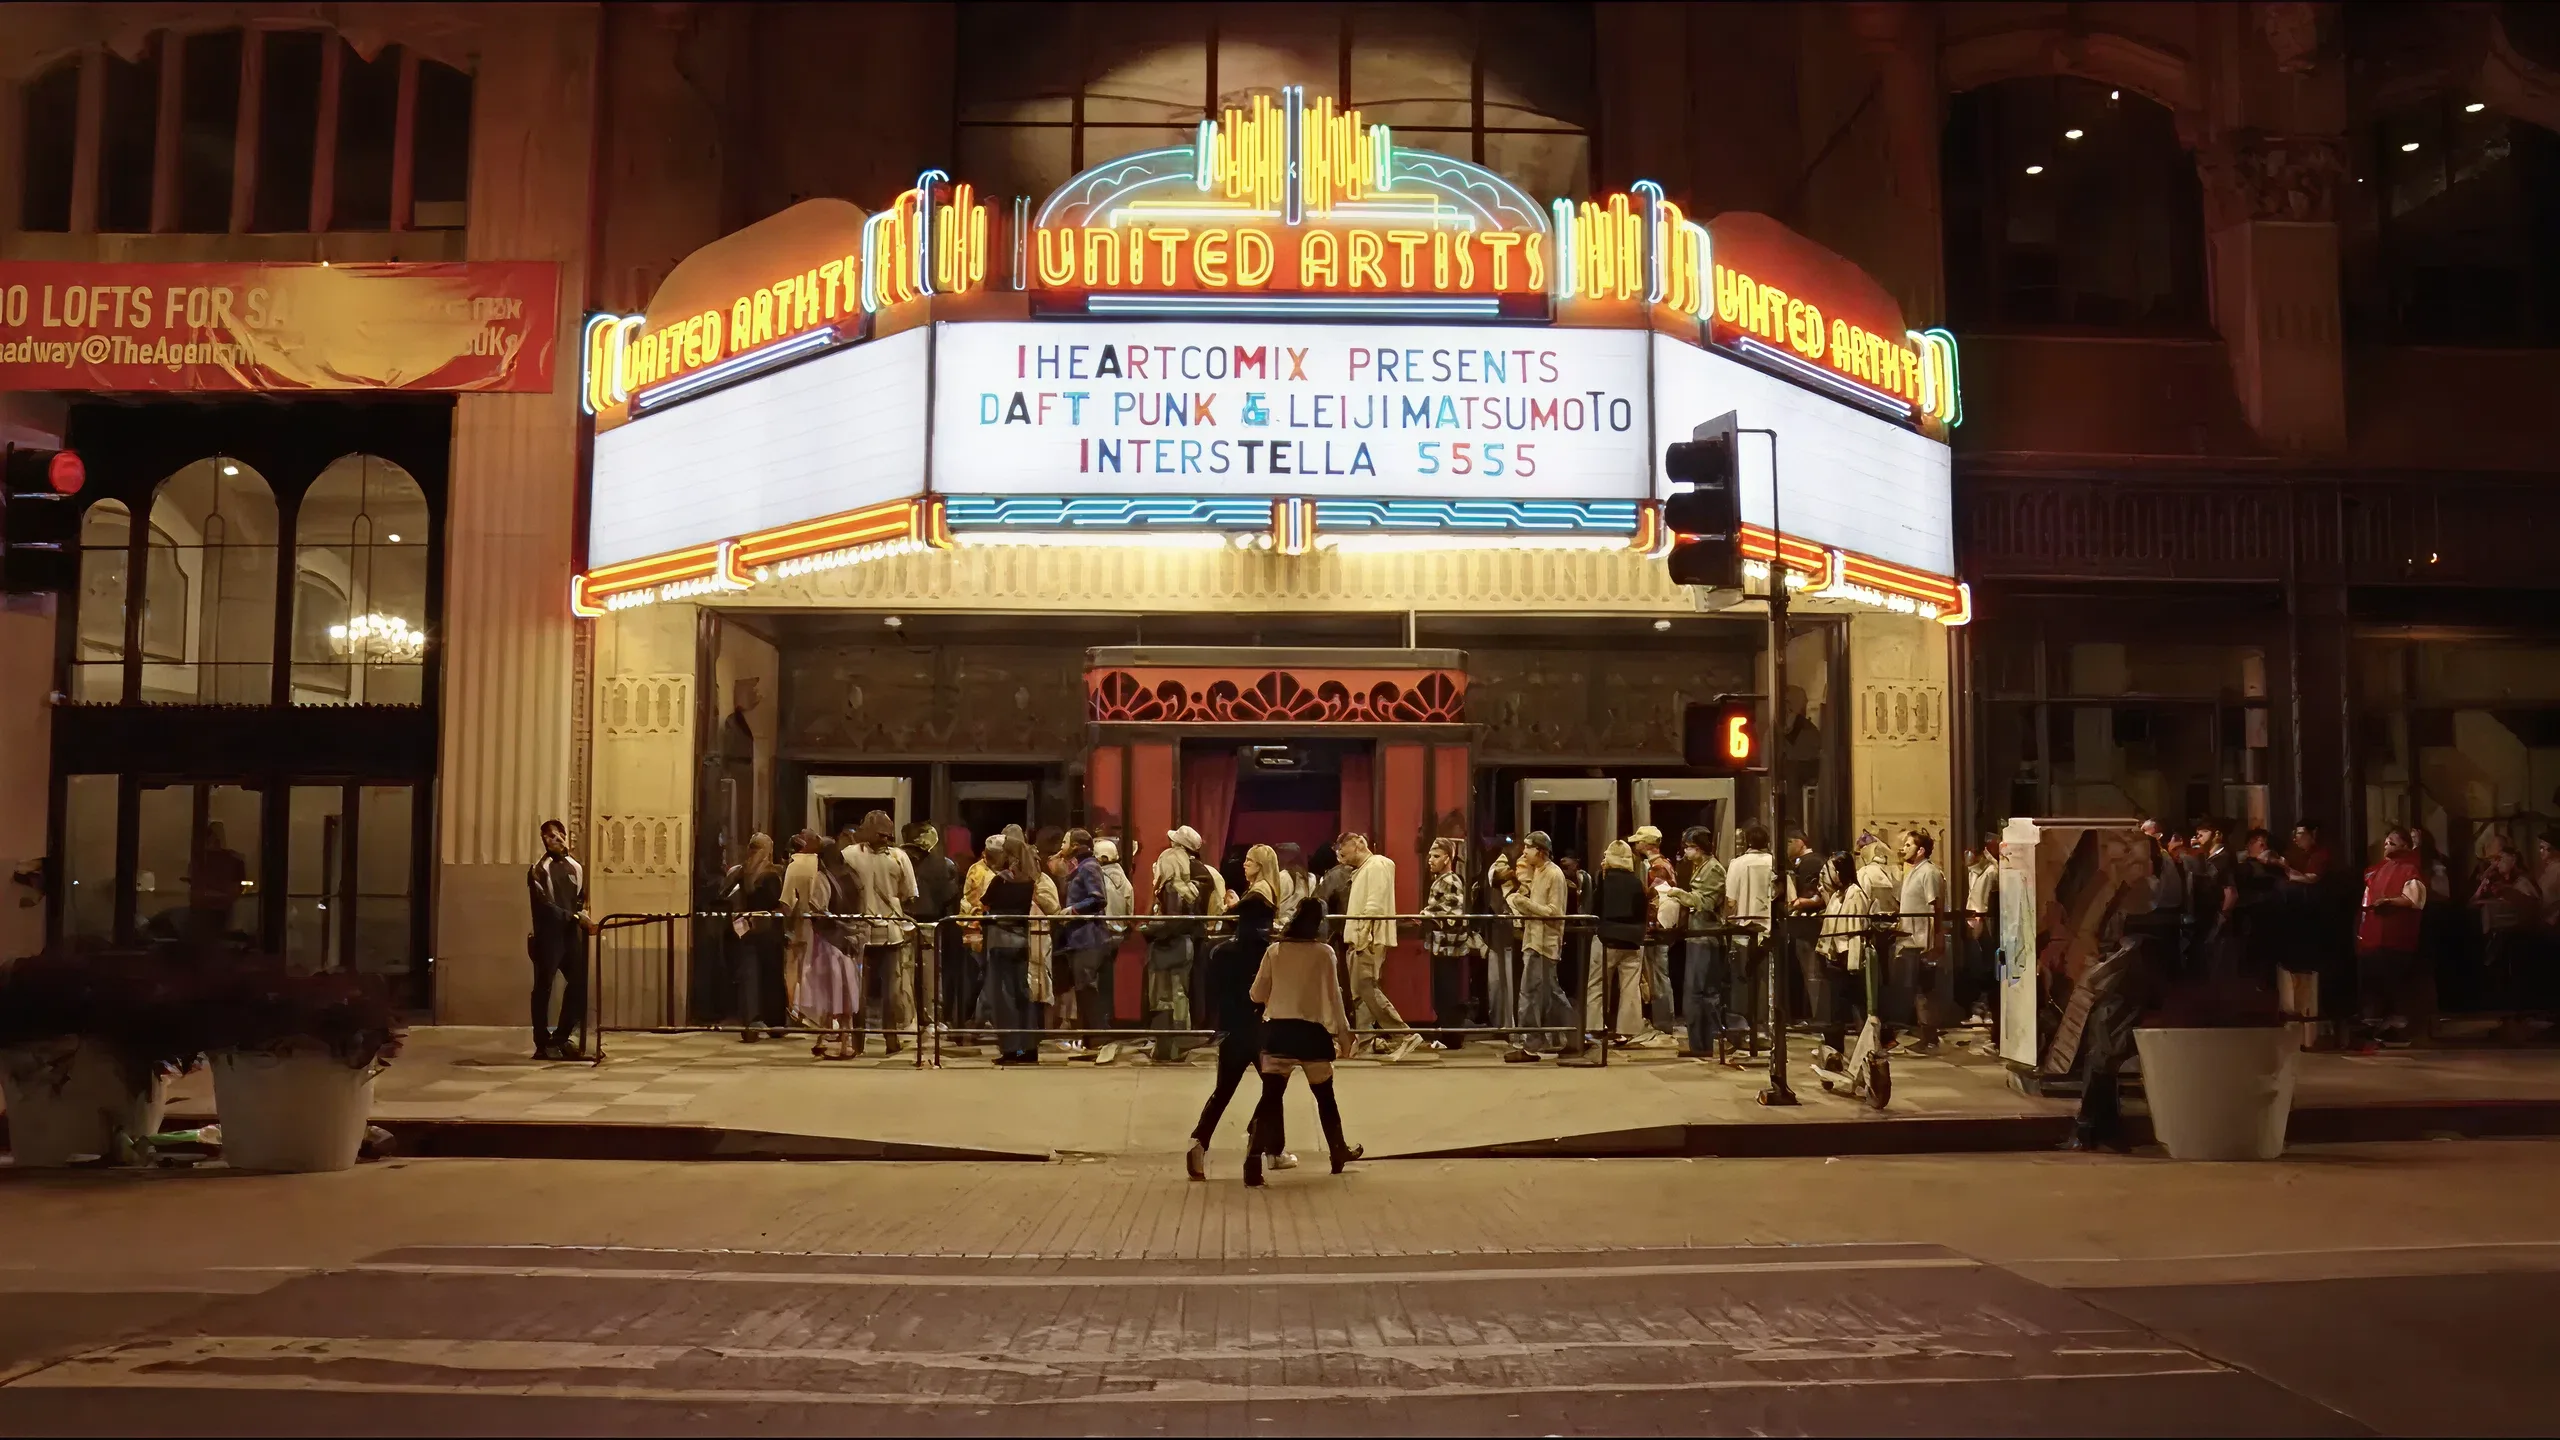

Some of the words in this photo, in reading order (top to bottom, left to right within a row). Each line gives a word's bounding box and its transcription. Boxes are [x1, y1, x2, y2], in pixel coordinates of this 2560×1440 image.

[1036, 227, 1276, 288] UNITED
[1301, 229, 1545, 291] ARTISTS
[42, 285, 153, 328] LOFTS
[165, 287, 234, 329] FOR
[1018, 344, 1310, 381] IHEARTCOMIX
[1350, 348, 1559, 384] PRESENTS
[980, 391, 1091, 426] DAFT
[1114, 391, 1217, 428] PUNK
[1241, 391, 1271, 428] &
[1080, 438, 1377, 477] INTERSTELLA
[1418, 442, 1536, 478] 5555
[1729, 716, 1750, 759] 6
